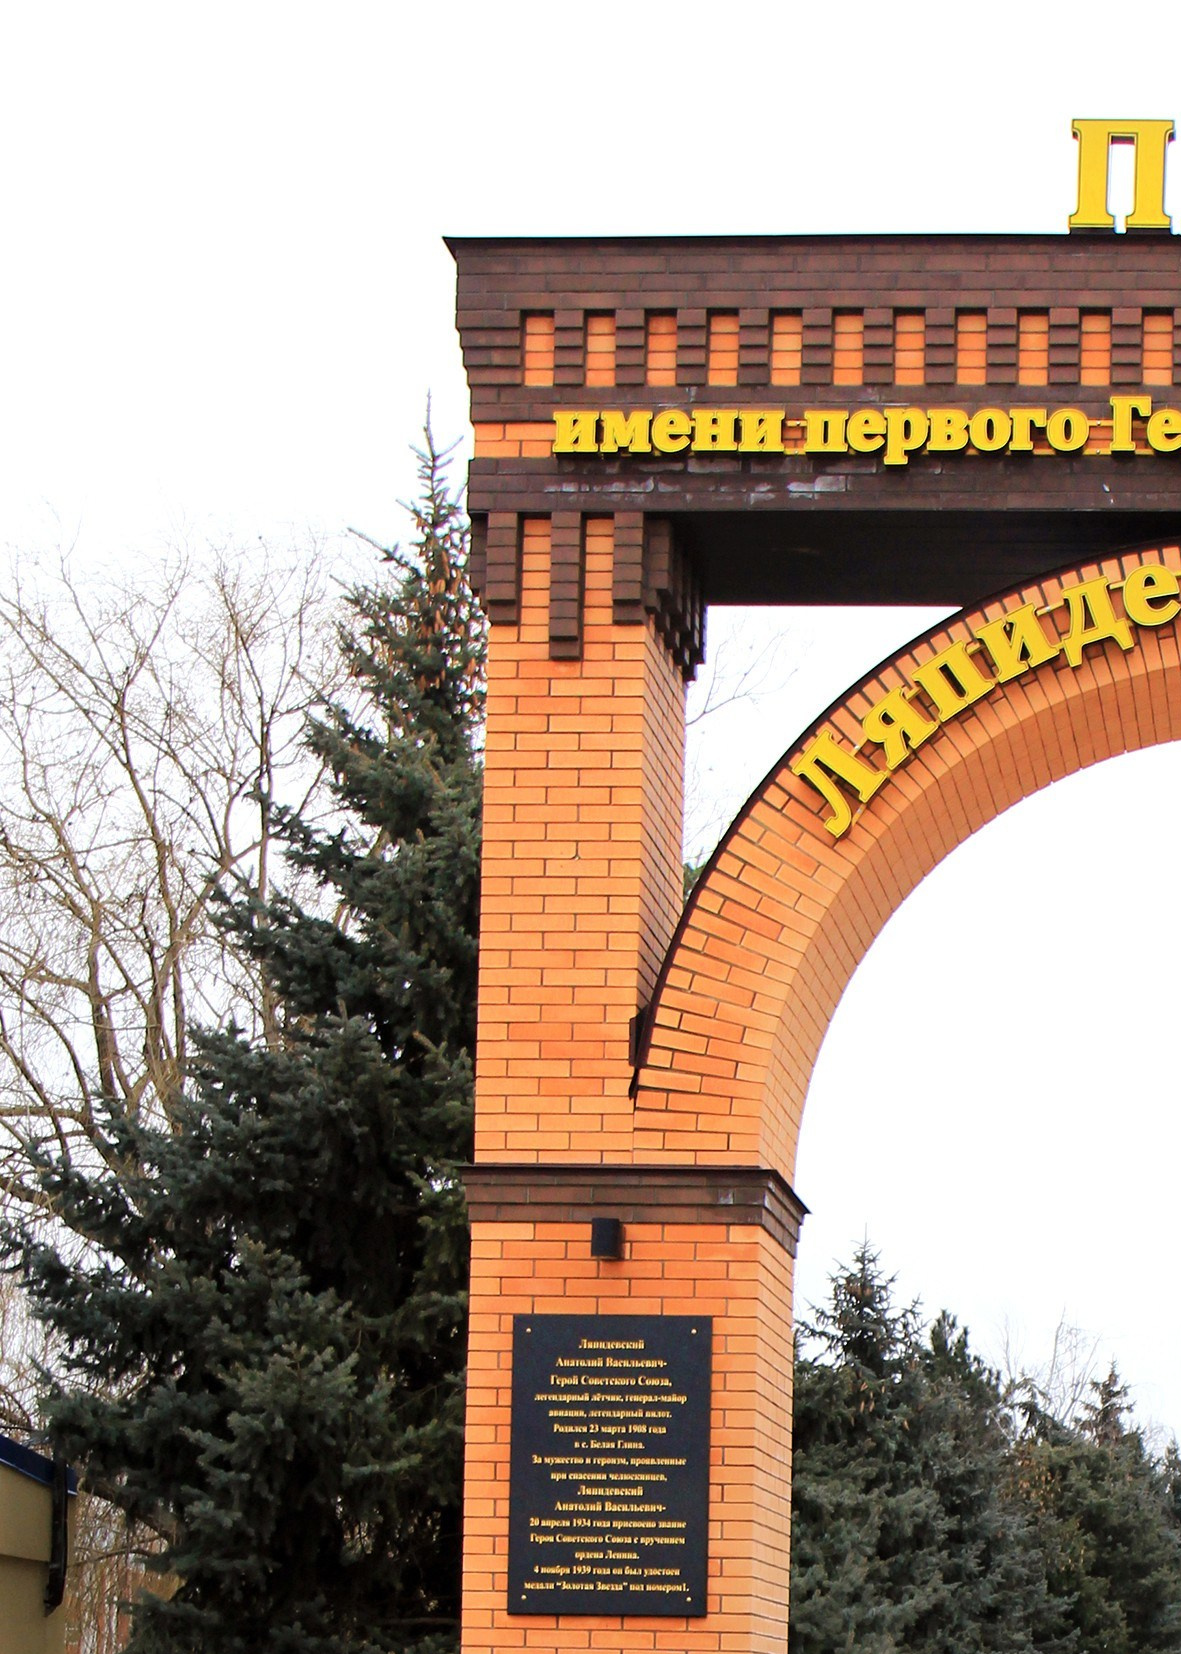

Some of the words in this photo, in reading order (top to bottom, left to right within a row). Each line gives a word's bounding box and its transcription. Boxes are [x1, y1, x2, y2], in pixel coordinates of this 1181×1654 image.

[553, 409, 788, 456] имени
[803, 409, 1090, 466] первого
[579, 1339, 644, 1350] Ляпидевский
[556, 1357, 603, 1367] Анатолий
[550, 1375, 578, 1385] Герой
[581, 1376, 636, 1386] Советского
[535, 1393, 589, 1403] легендарный
[588, 1409, 643, 1419] легендарный
[553, 1425, 587, 1433] Родился
[589, 1425, 599, 1433] 23
[601, 1427, 626, 1435] марта
[628, 1425, 647, 1433] 1908
[532, 1455, 542, 1463] За
[544, 1457, 584, 1465] мужество
[551, 1473, 567, 1481] при
[578, 1486, 643, 1496] Ляпидевский
[555, 1502, 601, 1512] Анатолий
[530, 1518, 539, 1526] 20
[541, 1519, 570, 1528] апреля
[573, 1519, 591, 1527] 1934
[556, 1534, 603, 1543] Советского
[605, 1535, 632, 1543] Союза
[575, 1552, 603, 1560] ордена
[573, 1566, 591, 1574] 1939
[625, 1566, 642, 1575] был
